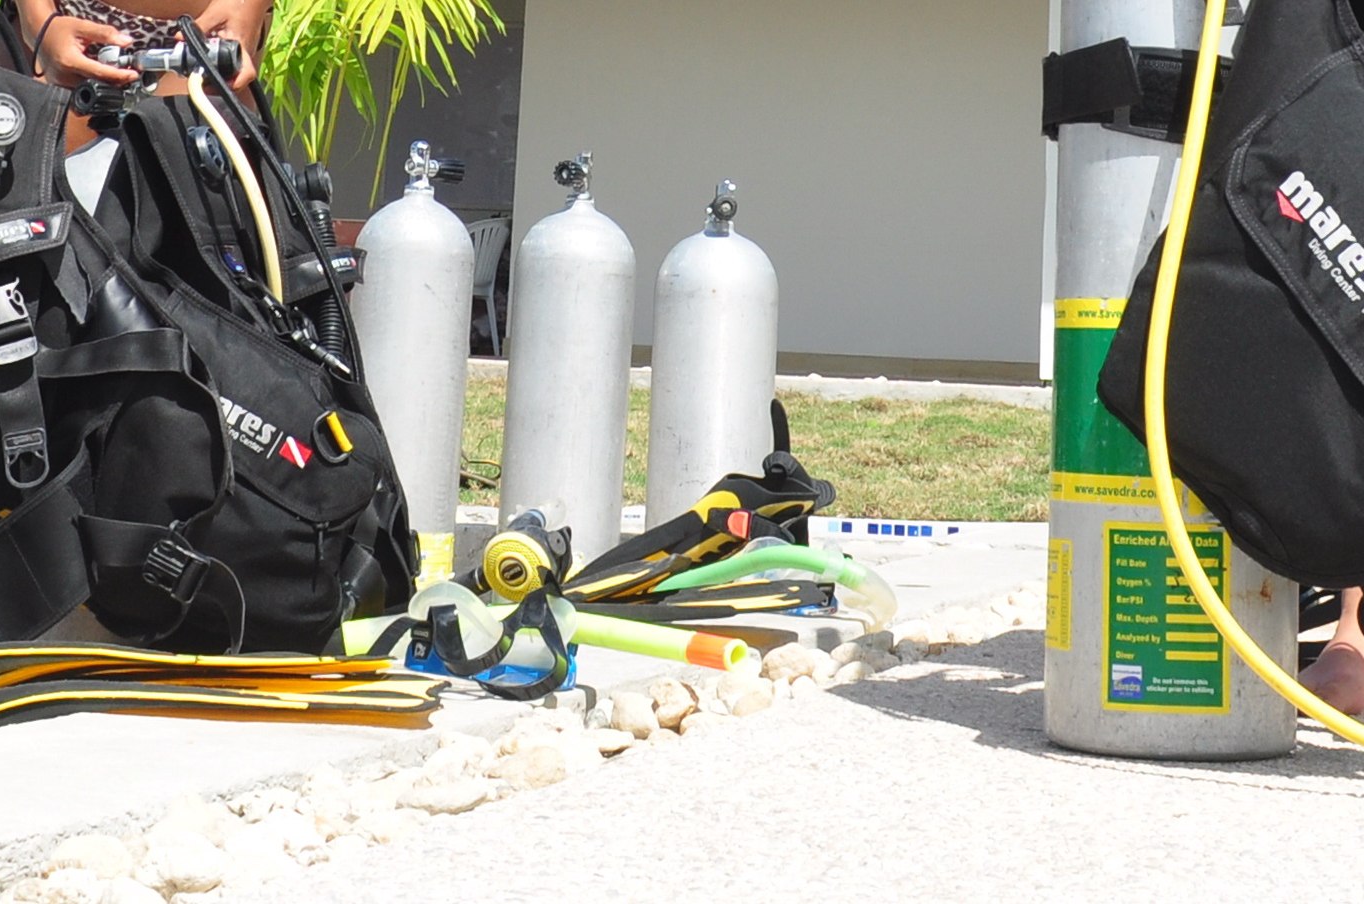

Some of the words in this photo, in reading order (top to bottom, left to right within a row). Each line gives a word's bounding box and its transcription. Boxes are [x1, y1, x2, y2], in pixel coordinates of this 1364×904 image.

[1307, 237, 1333, 271] Diving
[1330, 266, 1362, 302] Center
[218, 396, 277, 445] ares
[1074, 484, 1157, 499] www.savedra.co
[1113, 533, 1157, 546] Enriched
[1195, 537, 1219, 547] Data
[1129, 559, 1147, 568] Date
[1116, 577, 1143, 588] Oxygen
[1135, 614, 1158, 624] Depth
[1116, 632, 1150, 643] Analyzed
[1116, 650, 1135, 660] Diver
[1152, 676, 1161, 684] Do
[1168, 686, 1183, 694] prior
